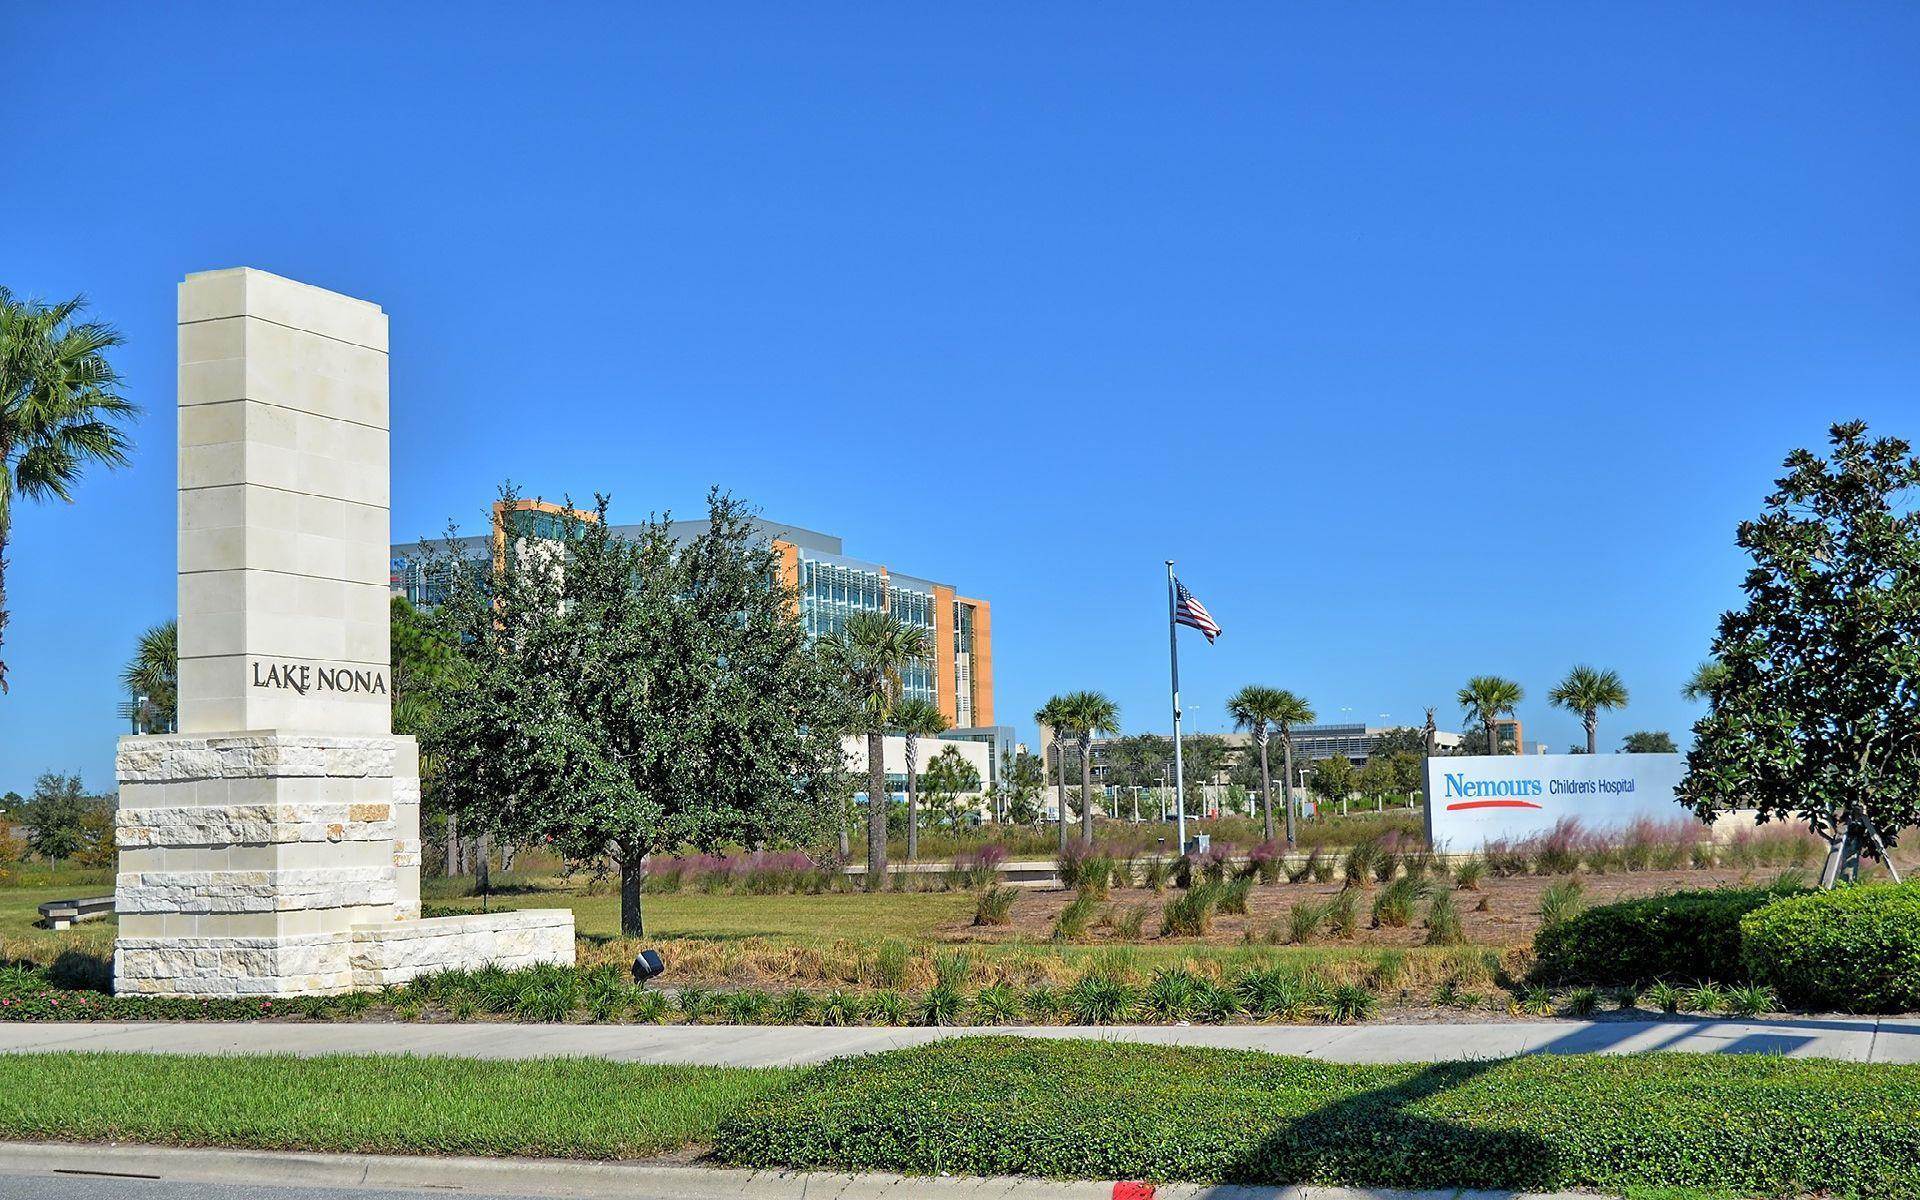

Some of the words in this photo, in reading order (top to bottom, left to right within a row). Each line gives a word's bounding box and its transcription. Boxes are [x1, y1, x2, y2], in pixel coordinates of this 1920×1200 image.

[253, 662, 311, 695] LAKE
[317, 667, 386, 694] NONA
[1444, 773, 1542, 797] Nemours
[1549, 779, 1596, 795] Children's
[1598, 778, 1635, 796] Hospital
